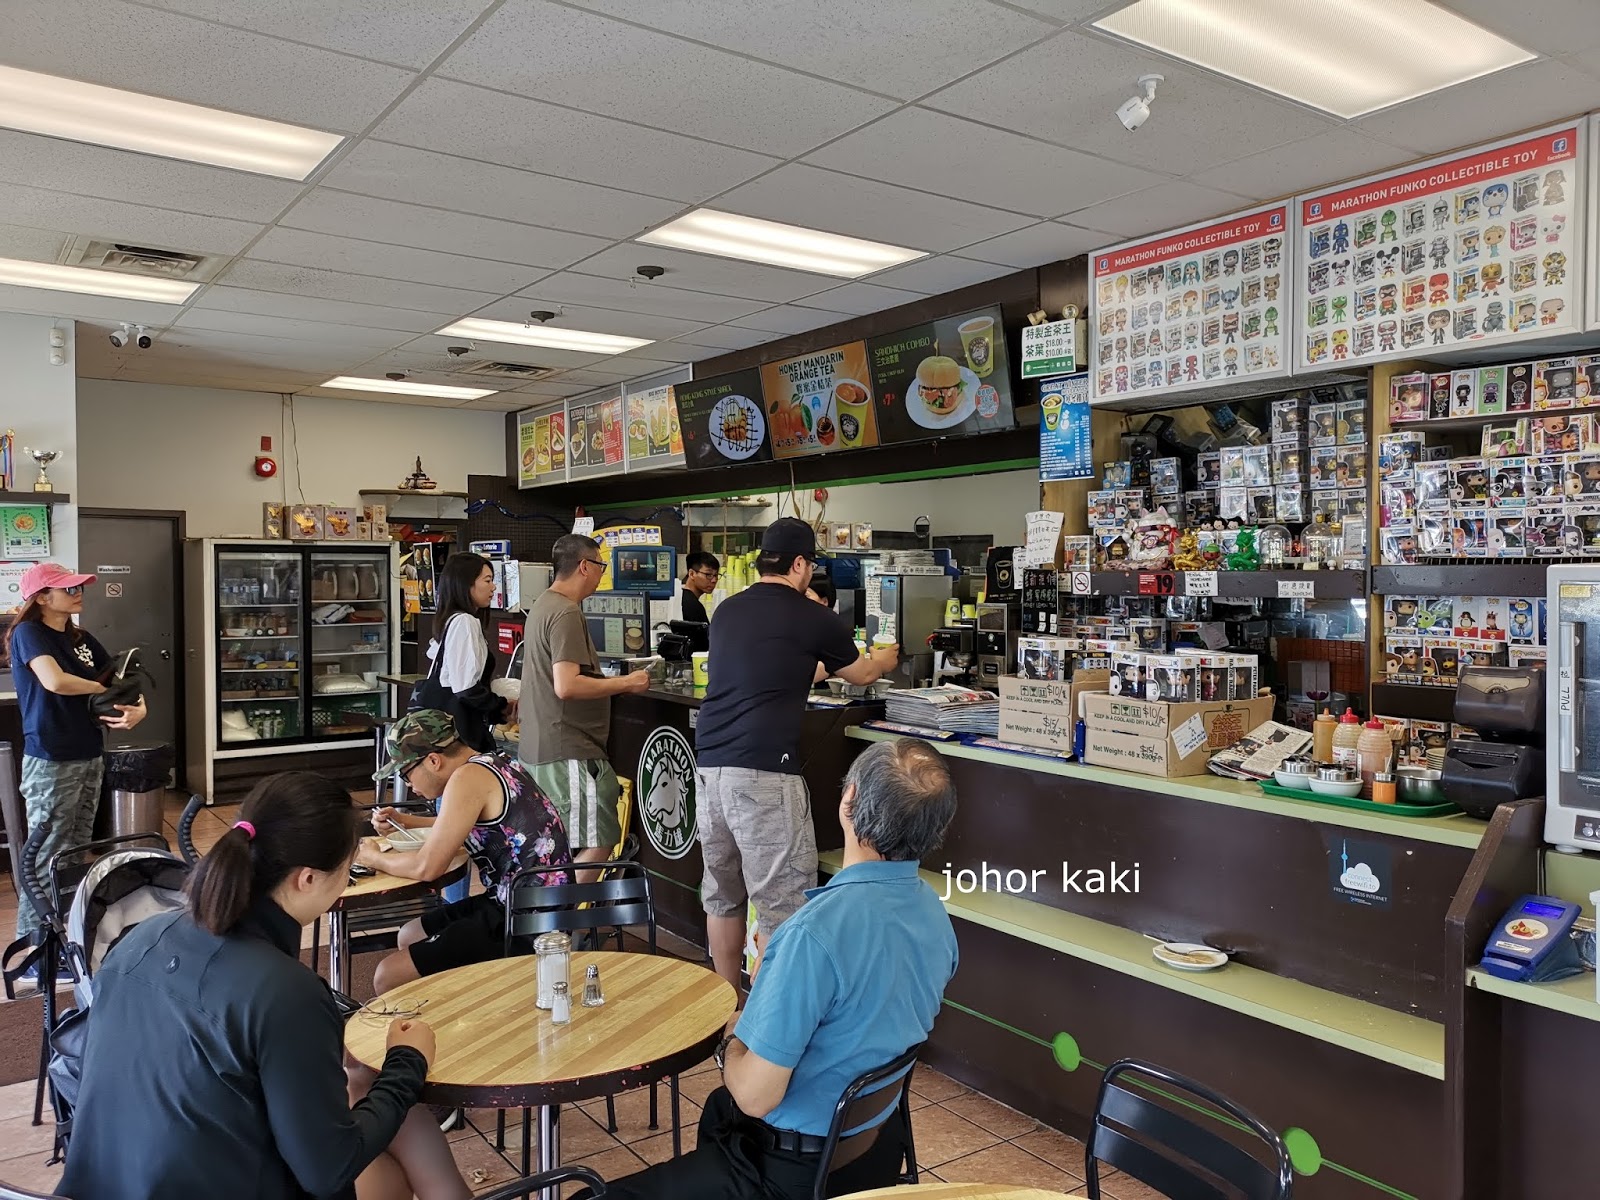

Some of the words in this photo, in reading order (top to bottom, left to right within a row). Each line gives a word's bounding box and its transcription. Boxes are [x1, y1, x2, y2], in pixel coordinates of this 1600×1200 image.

[1547, 151, 1571, 162] facebook
[1331, 188, 1387, 212] MARATHON
[1390, 179, 1427, 197] FUNKO
[1429, 156, 1510, 187] COLLECTIBLE
[1513, 149, 1538, 165] TOY
[1306, 214, 1324, 223] facebook
[1114, 249, 1155, 267] MARATHON
[1157, 243, 1183, 256] FUNKO
[1184, 226, 1241, 249] COLLECTIBLE
[1242, 222, 1261, 234] TOY
[1025, 322, 1071, 340] 特製金茶王
[874, 343, 906, 358] SANDWICH
[906, 337, 930, 351] COMBO
[1025, 343, 1044, 358] 茶葉
[1045, 338, 1063, 348] $18.00
[1045, 348, 1063, 358] $10.00
[778, 361, 802, 376] HONEY
[803, 350, 844, 370] MANDARIN
[789, 368, 819, 383] ORANGE
[820, 365, 836, 376] TEA
[1155, 574, 1173, 593] 19
[1561, 686, 1570, 711] PULL
[1006, 723, 1014, 731] Net
[1015, 724, 1032, 734] Weight
[1146, 720, 1161, 728] PLACE
[1211, 713, 1242, 733] 金茶王
[1092, 744, 1103, 752] Net
[1103, 746, 1124, 756] Weight
[644, 738, 693, 783] MARATHON
[1344, 889, 1366, 898] WIRELESS
[1366, 893, 1388, 902] INTERNET
